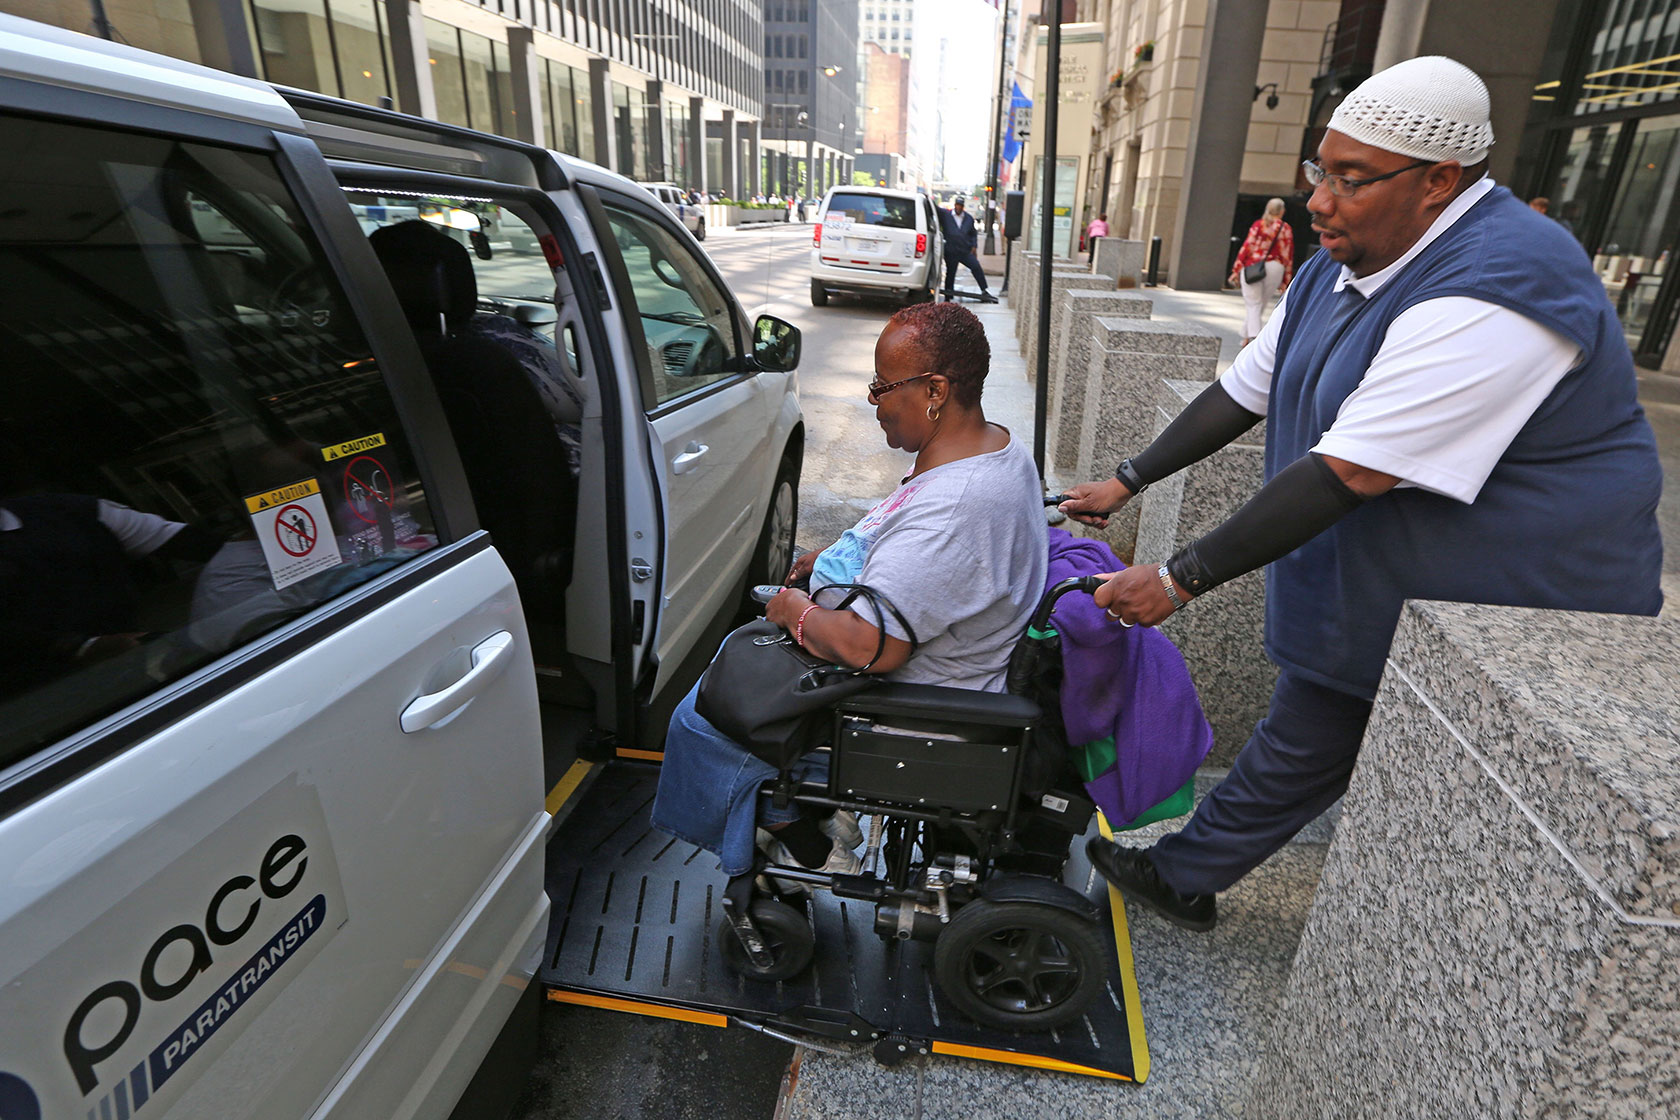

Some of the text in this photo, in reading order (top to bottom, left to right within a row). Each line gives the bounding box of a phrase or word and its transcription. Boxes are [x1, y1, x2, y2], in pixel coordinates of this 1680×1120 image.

[341, 436, 382, 455] CAUTION
[271, 482, 312, 504] CAUTION
[64, 834, 308, 1097] pace
[162, 906, 316, 1069] PARATRANSIT
